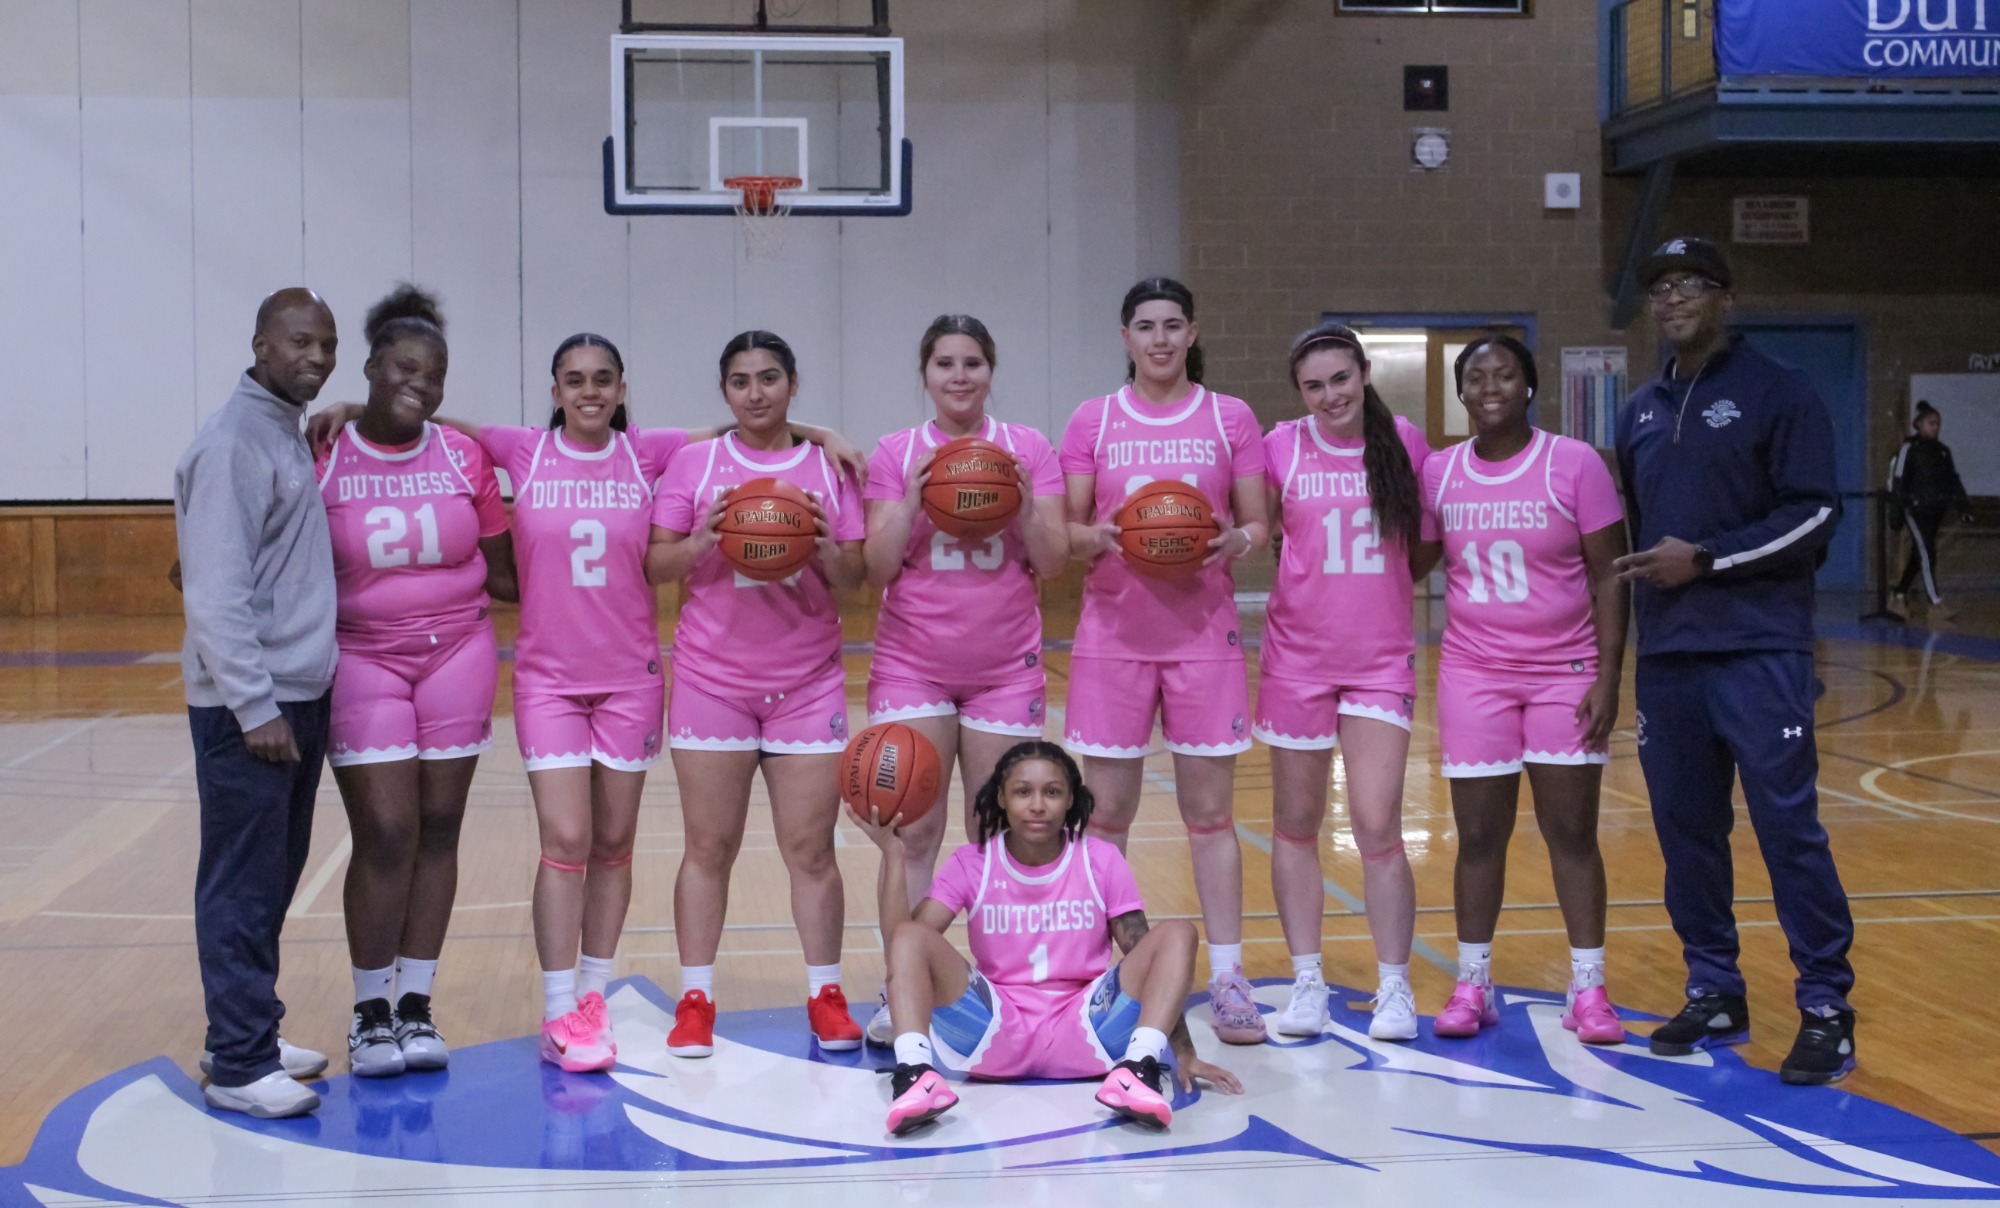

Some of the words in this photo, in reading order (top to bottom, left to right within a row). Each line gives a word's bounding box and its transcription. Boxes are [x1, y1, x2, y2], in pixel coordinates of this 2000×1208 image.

[945, 460, 1010, 479] SPALDING
[1107, 438, 1216, 470] DUTCHESS
[338, 472, 455, 501] DUTCHESS
[532, 480, 641, 509] DUTCHESS
[957, 490, 998, 510] NJCAA
[1298, 471, 1368, 500] DUTCH
[734, 510, 801, 529] SPALDING
[1137, 504, 1201, 523] SPALDING
[1442, 500, 1548, 532] DUTCHESS
[365, 503, 442, 568] 21
[743, 541, 786, 560] NJCAA
[1139, 535, 1200, 548] LEGACY
[1322, 508, 1385, 574] 12
[570, 519, 607, 587] 2
[1461, 540, 1530, 604] 10
[850, 732, 876, 796] SPALDING
[876, 746, 895, 791] NJCAA
[982, 900, 1095, 935] DUTCHESS
[1028, 944, 1049, 983] 1
